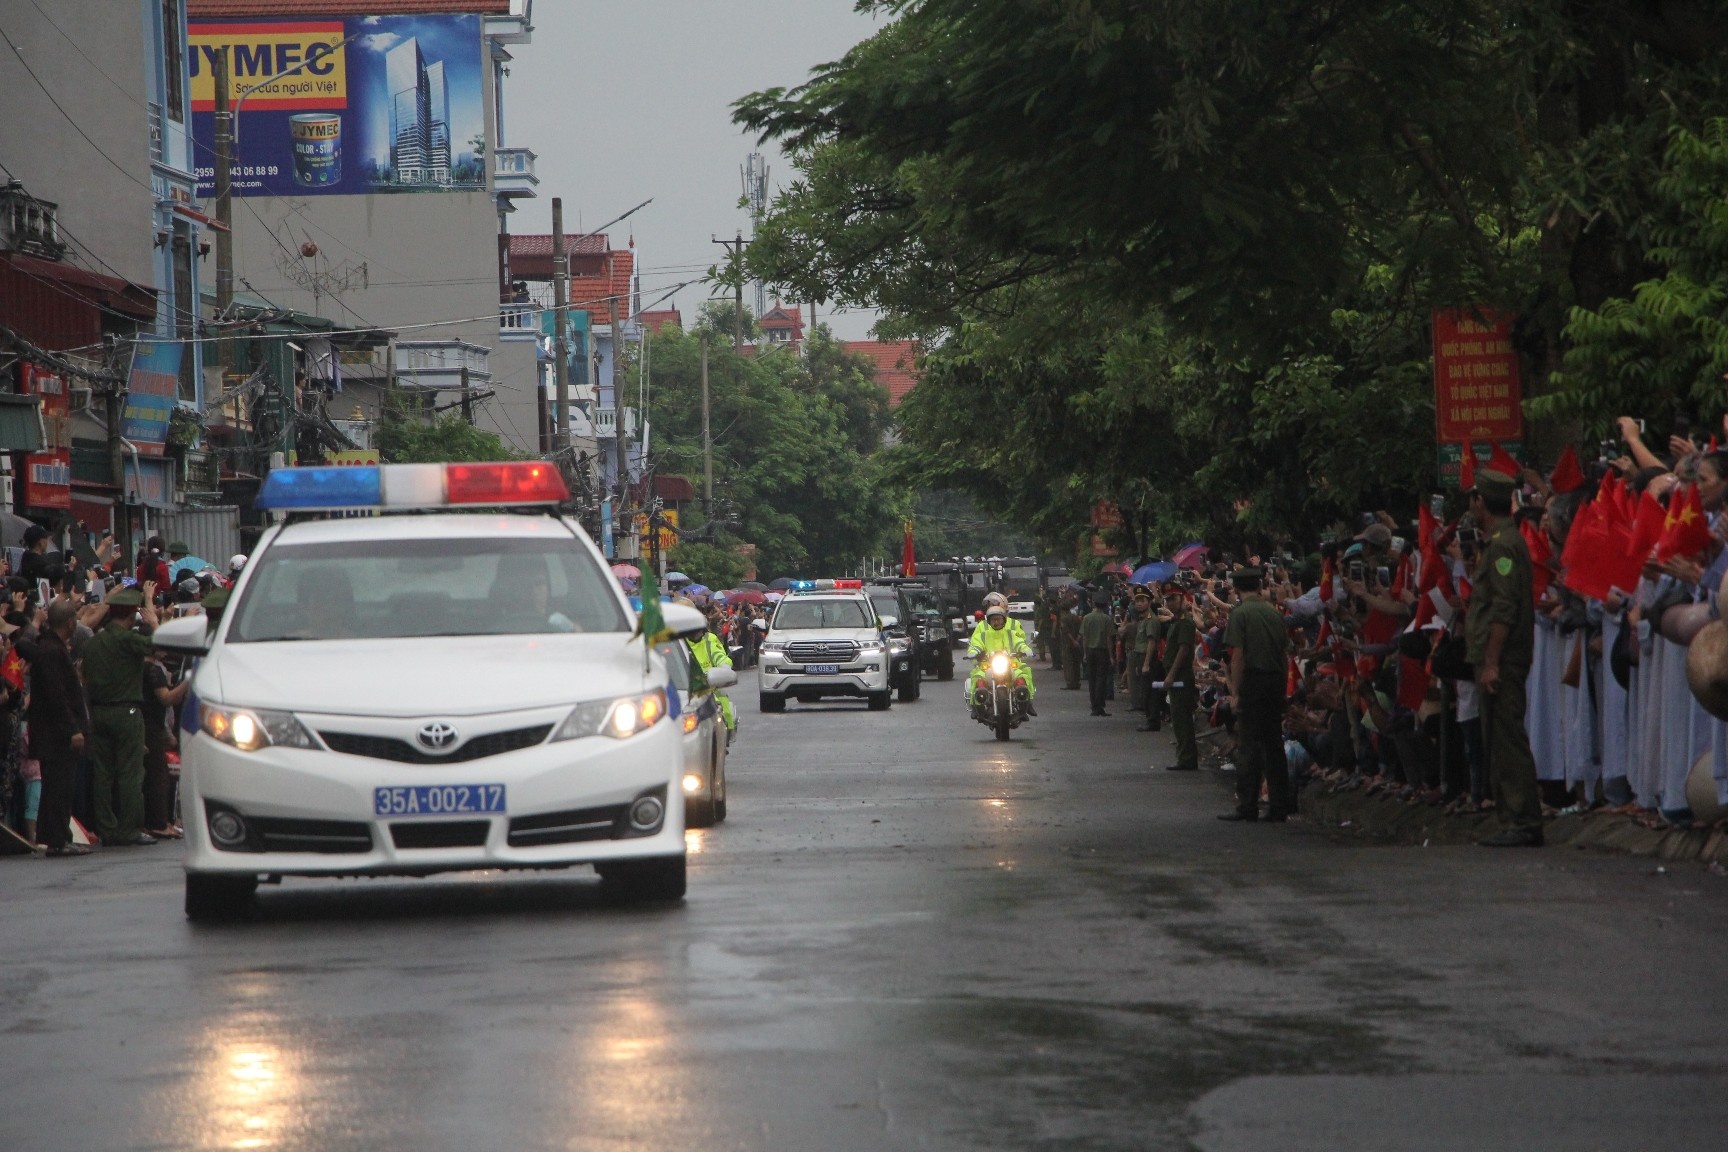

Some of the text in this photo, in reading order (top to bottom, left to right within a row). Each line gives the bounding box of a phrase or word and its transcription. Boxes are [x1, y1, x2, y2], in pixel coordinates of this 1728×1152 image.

[282, 81, 313, 96] người
[316, 81, 337, 95] Việt
[243, 166, 254, 176] 06
[255, 166, 266, 175] 88
[267, 165, 279, 175] 99
[378, 786, 502, 813] 35A-002.17
